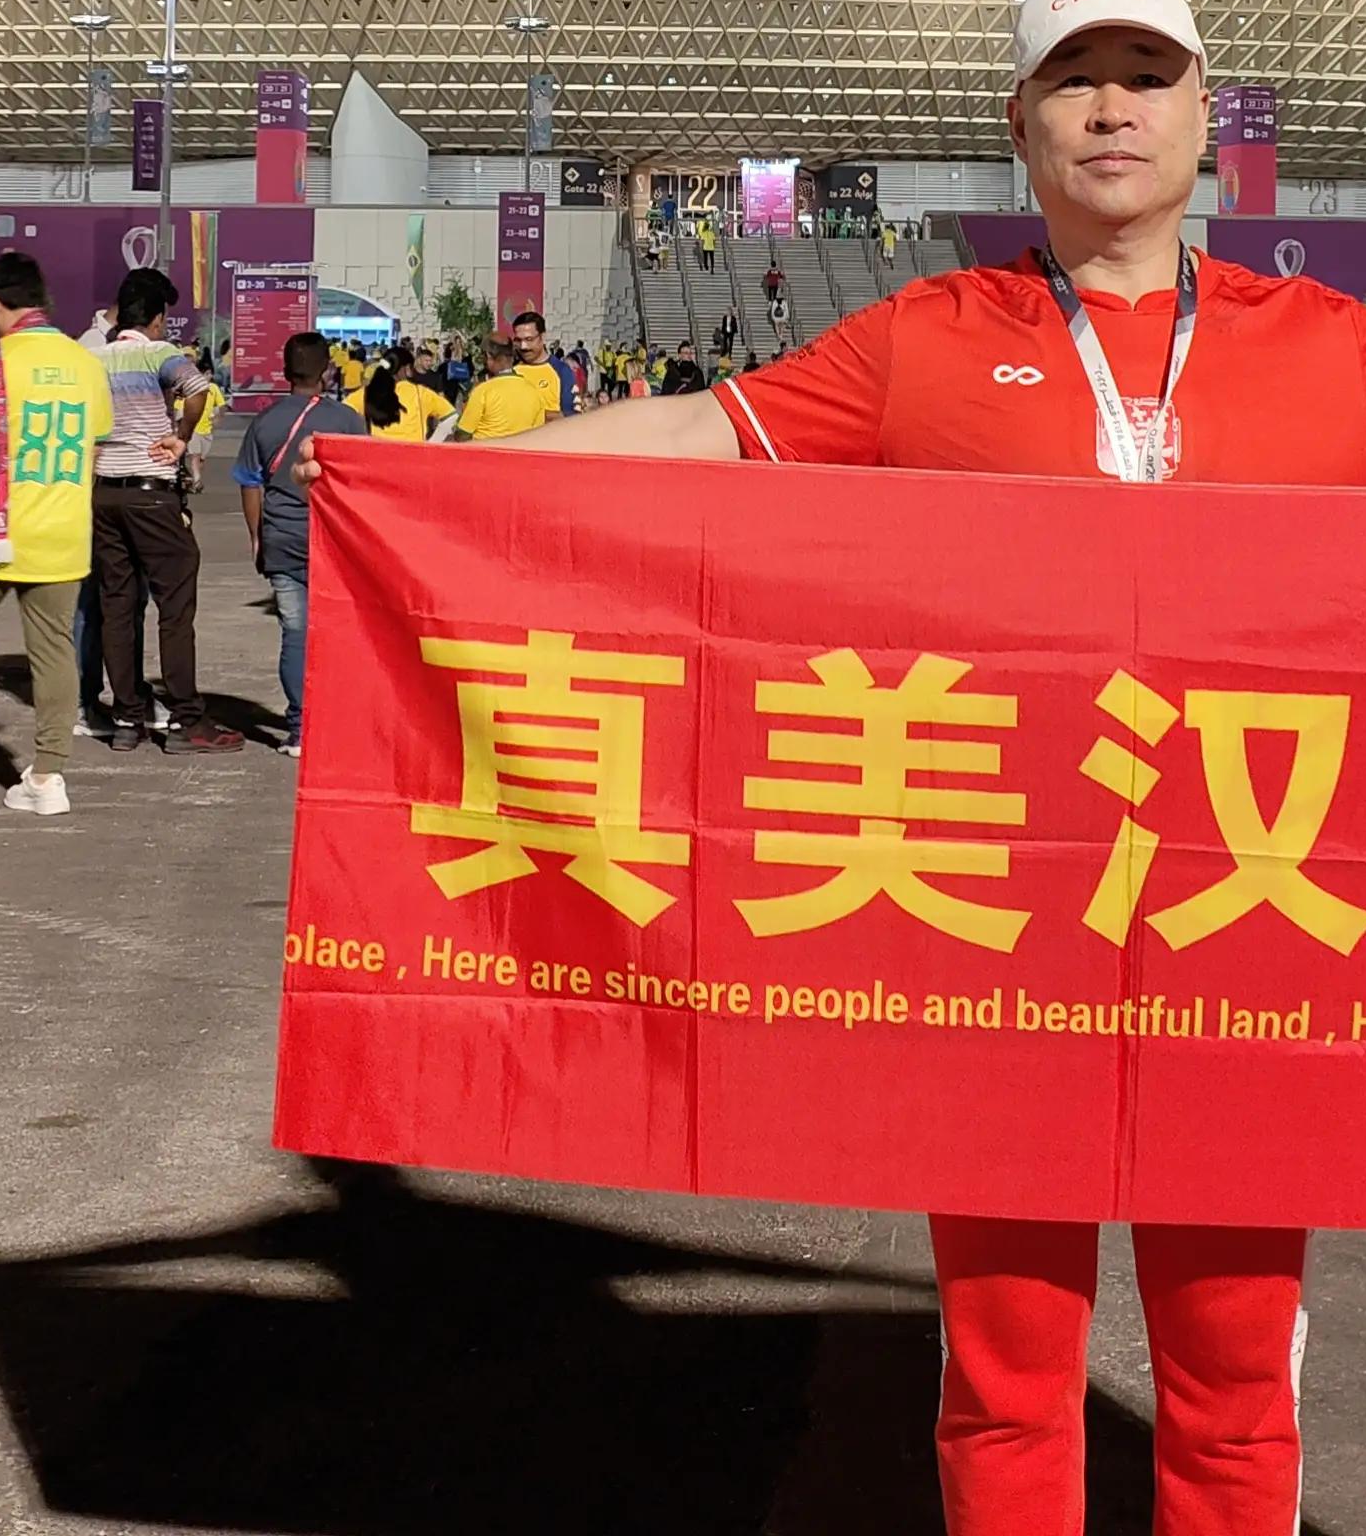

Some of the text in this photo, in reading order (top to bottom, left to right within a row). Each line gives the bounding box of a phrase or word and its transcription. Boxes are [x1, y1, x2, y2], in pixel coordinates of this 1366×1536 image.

[564, 185, 585, 193] Gate
[687, 175, 718, 211] 22
[839, 187, 853, 198] 22
[1309, 179, 1338, 215] 23
[422, 934, 519, 986] Here
[530, 959, 592, 995] are
[604, 962, 751, 1015] sincere
[764, 978, 910, 1030] people
[921, 986, 1003, 1030] and
[1015, 987, 1204, 1038] beautiful
[1218, 997, 1311, 1041] land
